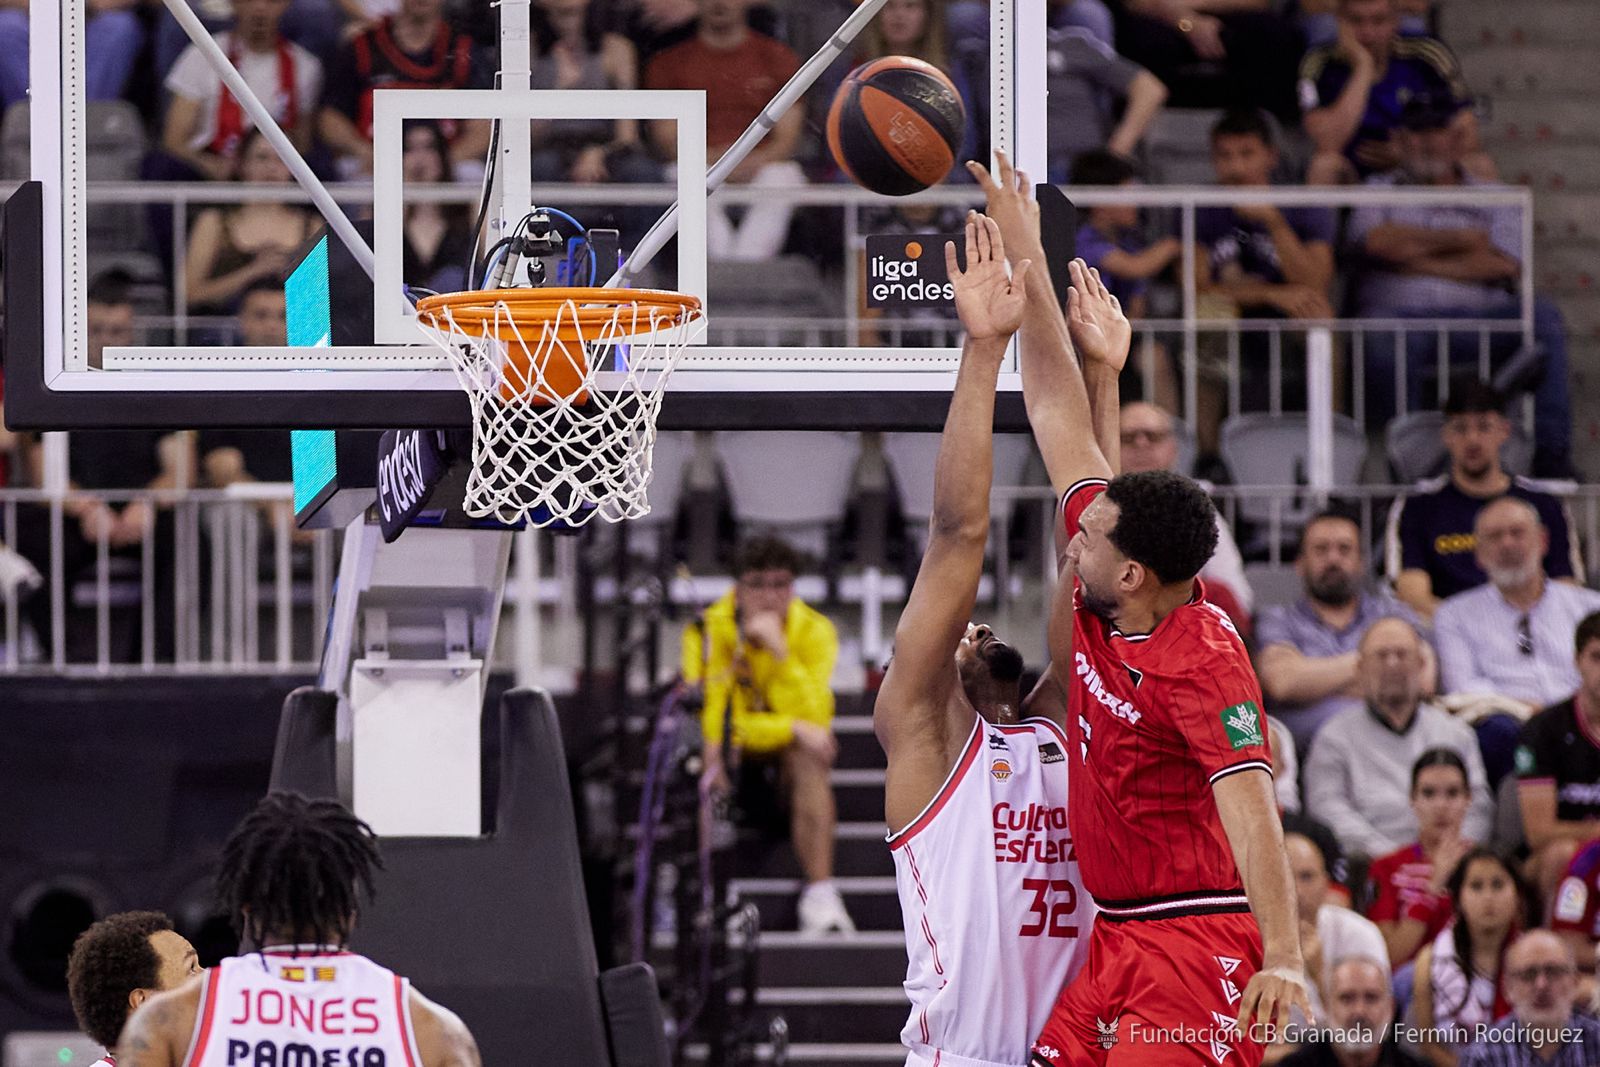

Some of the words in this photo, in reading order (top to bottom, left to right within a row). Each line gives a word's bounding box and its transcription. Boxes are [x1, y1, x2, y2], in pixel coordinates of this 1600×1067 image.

[872, 255, 918, 281] liga
[872, 278, 955, 301] endes
[1018, 877, 1079, 938] 32
[230, 988, 380, 1036] JONES
[227, 1037, 386, 1067] PAMESA
